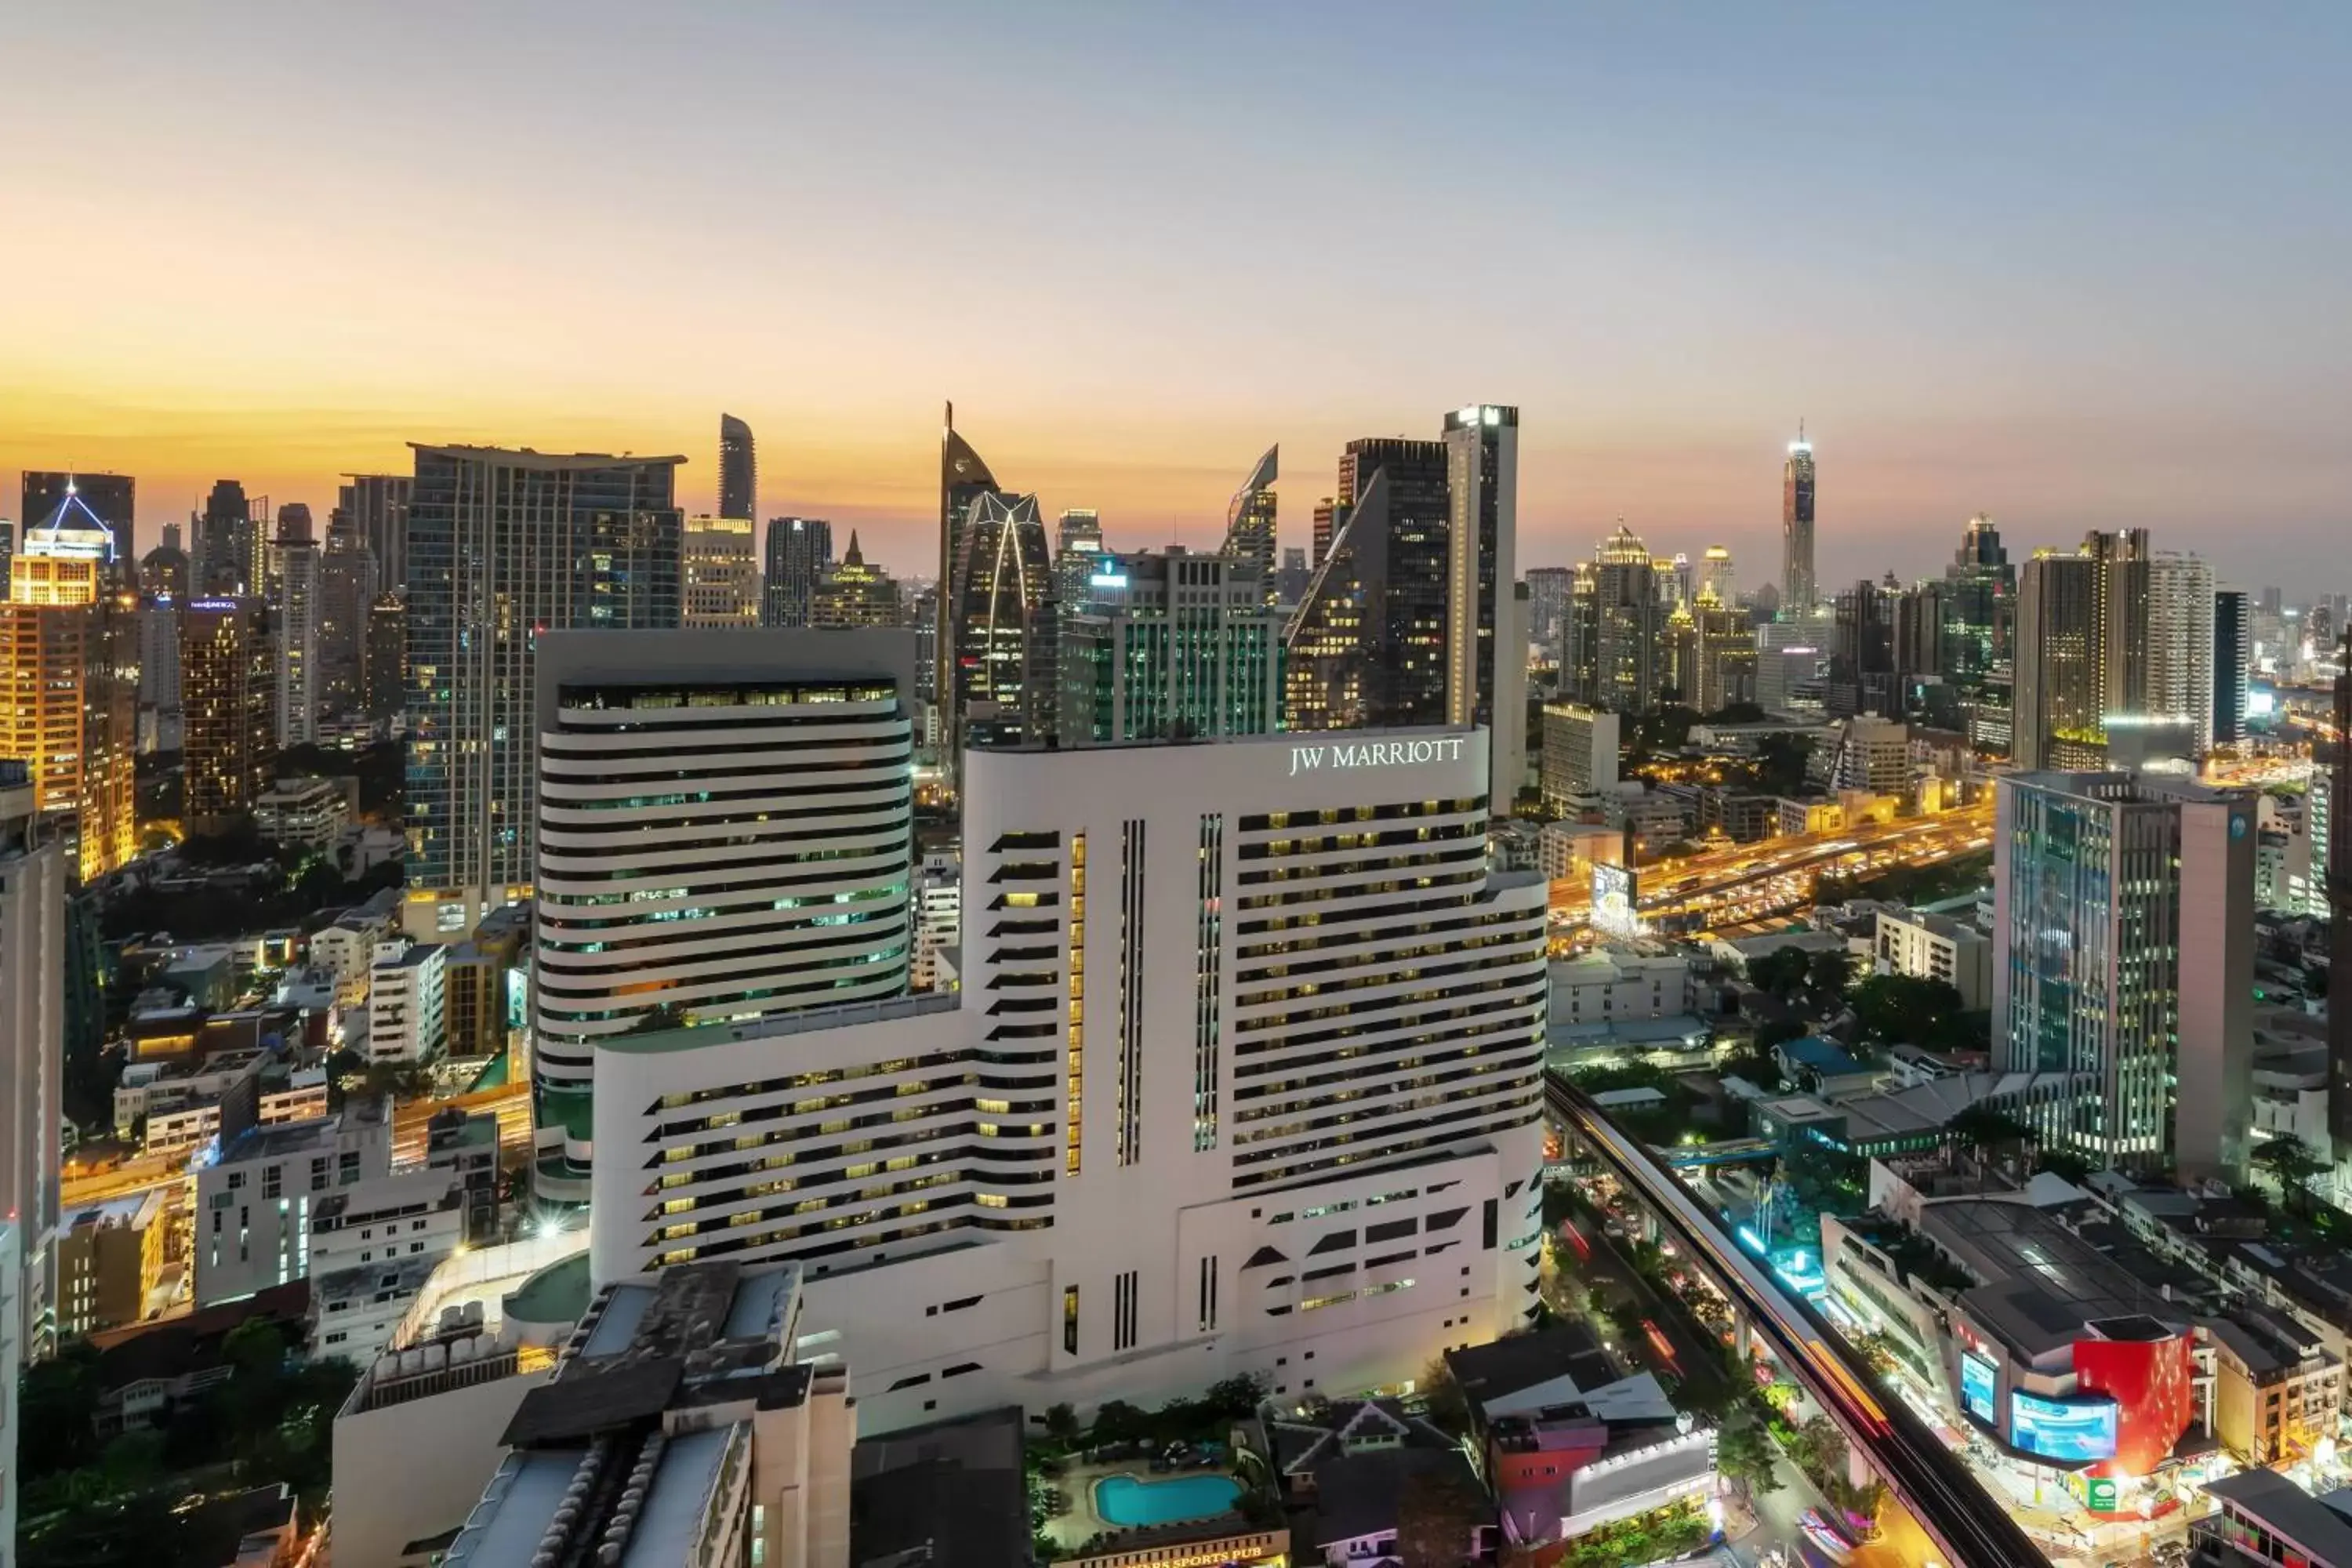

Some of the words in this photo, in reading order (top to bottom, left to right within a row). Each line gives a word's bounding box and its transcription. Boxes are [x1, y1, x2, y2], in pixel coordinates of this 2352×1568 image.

[1290, 747, 1325, 776] JW
[1333, 739, 1464, 768] MARRIOTT
[1173, 1552, 1229, 1567] SPORTS
[1232, 1547, 1261, 1559] PUB
